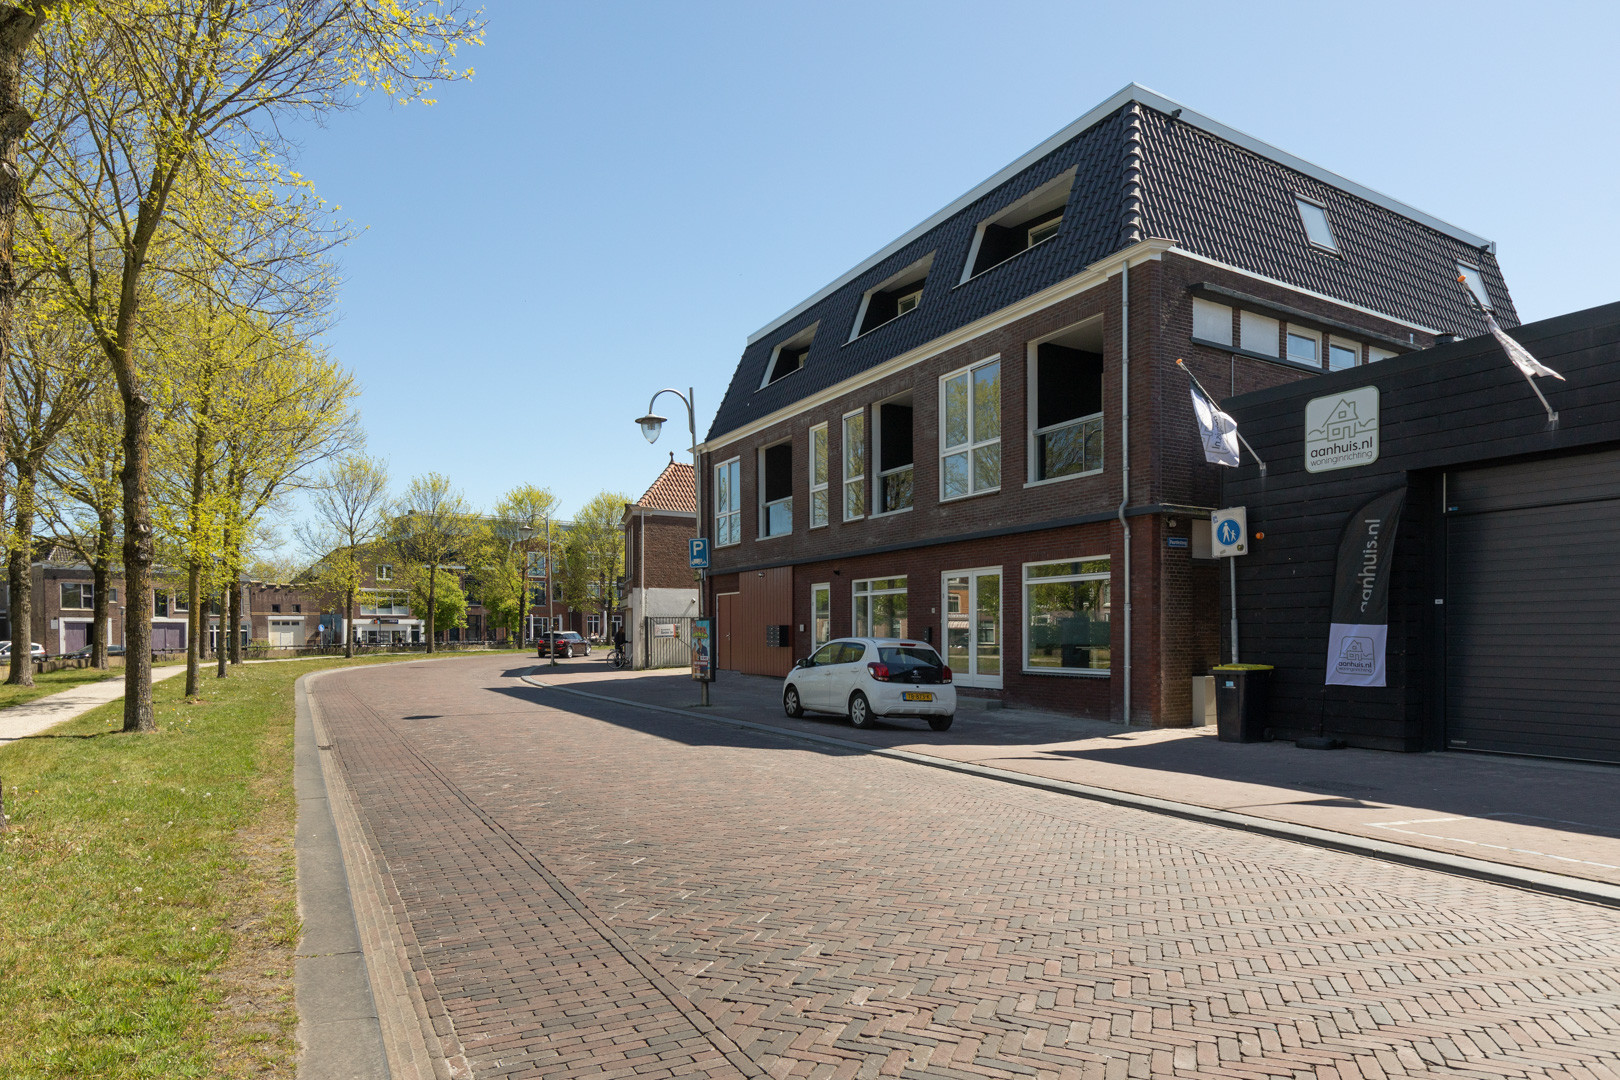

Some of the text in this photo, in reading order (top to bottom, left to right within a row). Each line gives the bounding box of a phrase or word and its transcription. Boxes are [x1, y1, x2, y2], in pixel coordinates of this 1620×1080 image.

[1310, 435, 1373, 458] aanhuis.nl
[1310, 450, 1373, 467] woninginrichting
[693, 541, 704, 556] P
[1338, 660, 1372, 668] aanhuis.nl
